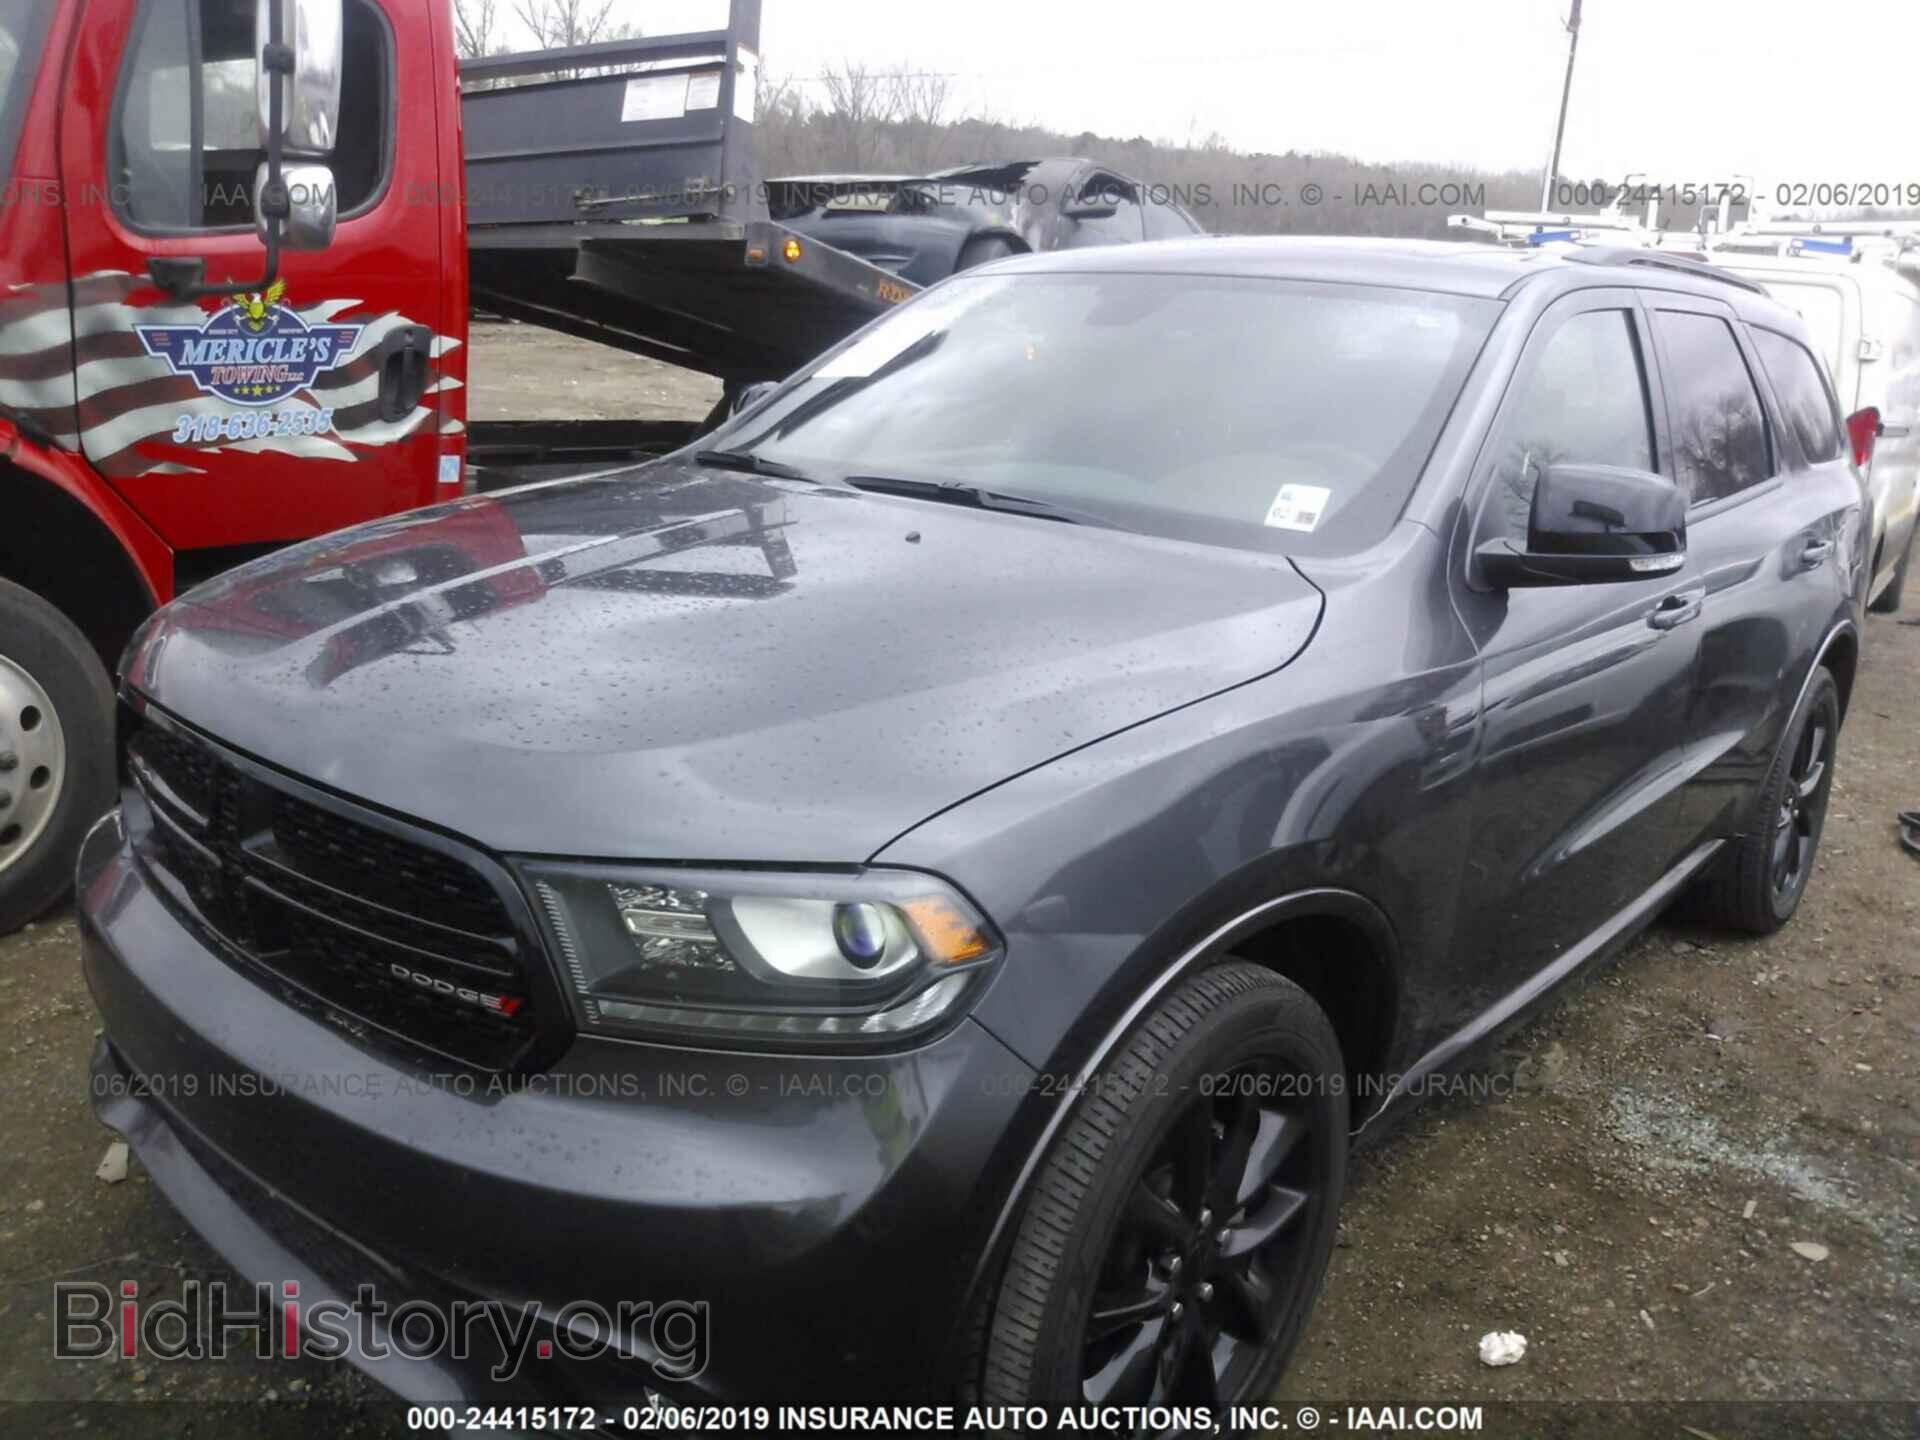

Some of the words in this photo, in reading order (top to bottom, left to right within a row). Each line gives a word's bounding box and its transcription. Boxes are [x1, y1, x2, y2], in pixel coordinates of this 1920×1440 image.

[178, 337, 332, 366] MERICLE'S
[211, 364, 289, 385] TOWING
[173, 408, 334, 443] 318-636-2535
[391, 963, 512, 1017] DODGE
